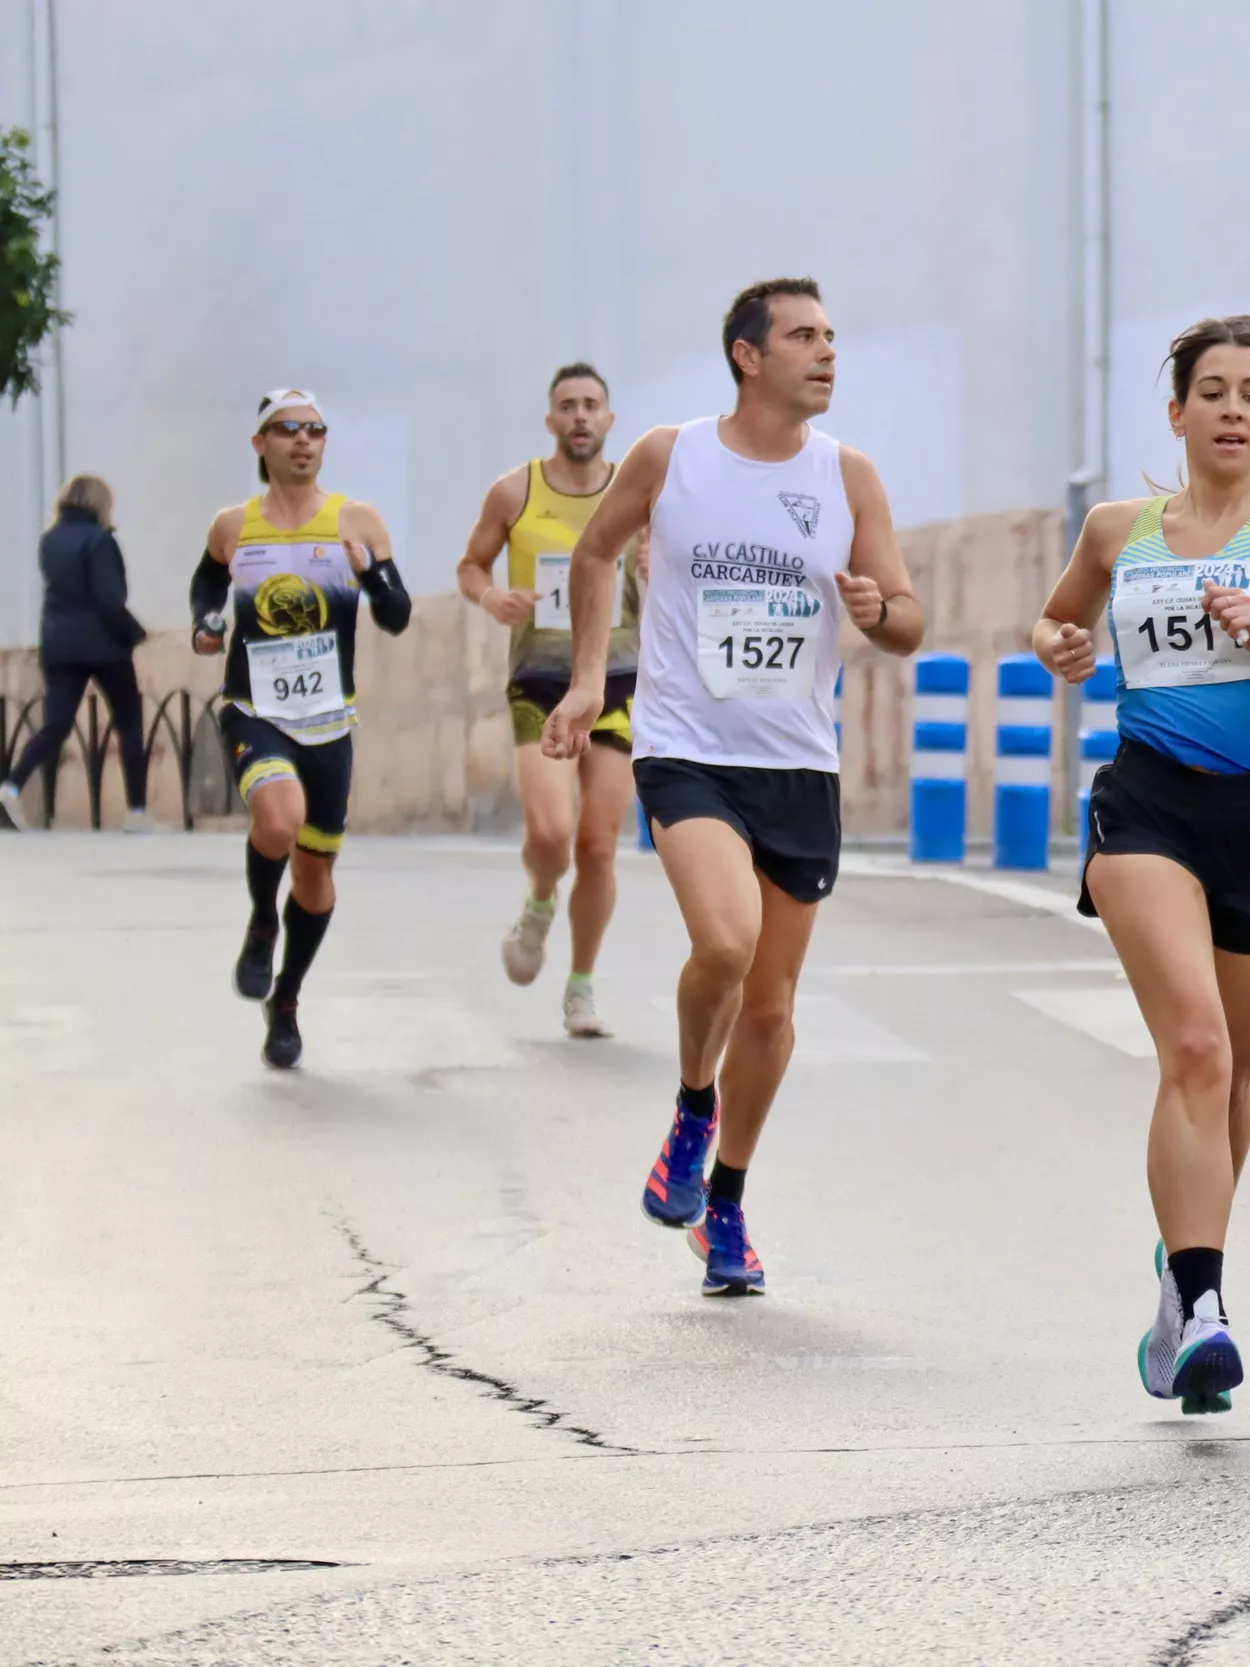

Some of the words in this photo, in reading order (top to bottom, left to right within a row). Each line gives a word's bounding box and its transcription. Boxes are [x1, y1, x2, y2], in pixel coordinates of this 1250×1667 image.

[725, 542, 804, 570] CASTILLO
[691, 563, 807, 588] CARCABUEY
[1196, 564, 1235, 578] 2024
[1138, 613, 1245, 653] 151
[718, 636, 805, 669] 1527
[273, 671, 324, 701] 942
